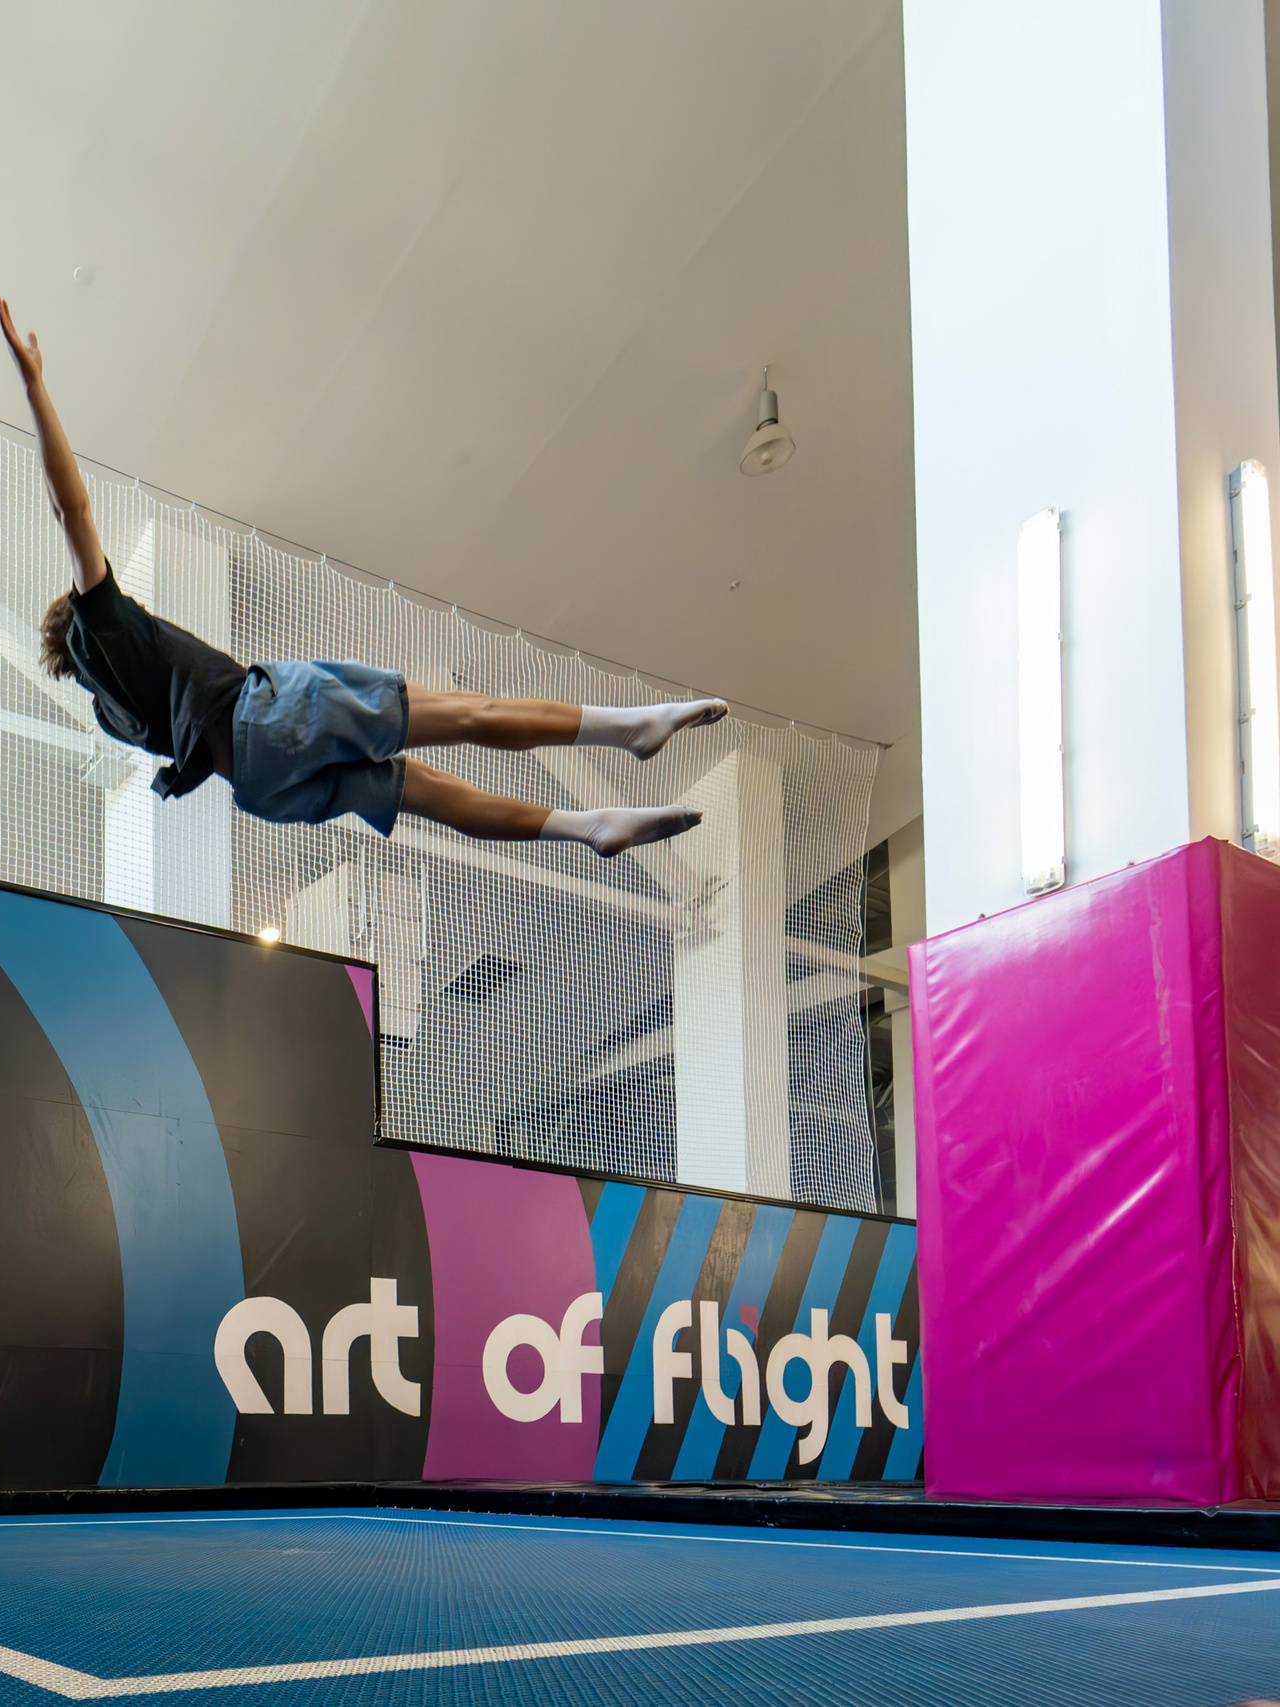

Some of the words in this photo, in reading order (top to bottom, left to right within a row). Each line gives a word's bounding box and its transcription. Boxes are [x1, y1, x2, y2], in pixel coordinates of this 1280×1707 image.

[214, 1277, 421, 1417] art
[482, 1292, 604, 1423] of
[652, 1300, 910, 1465] flight
